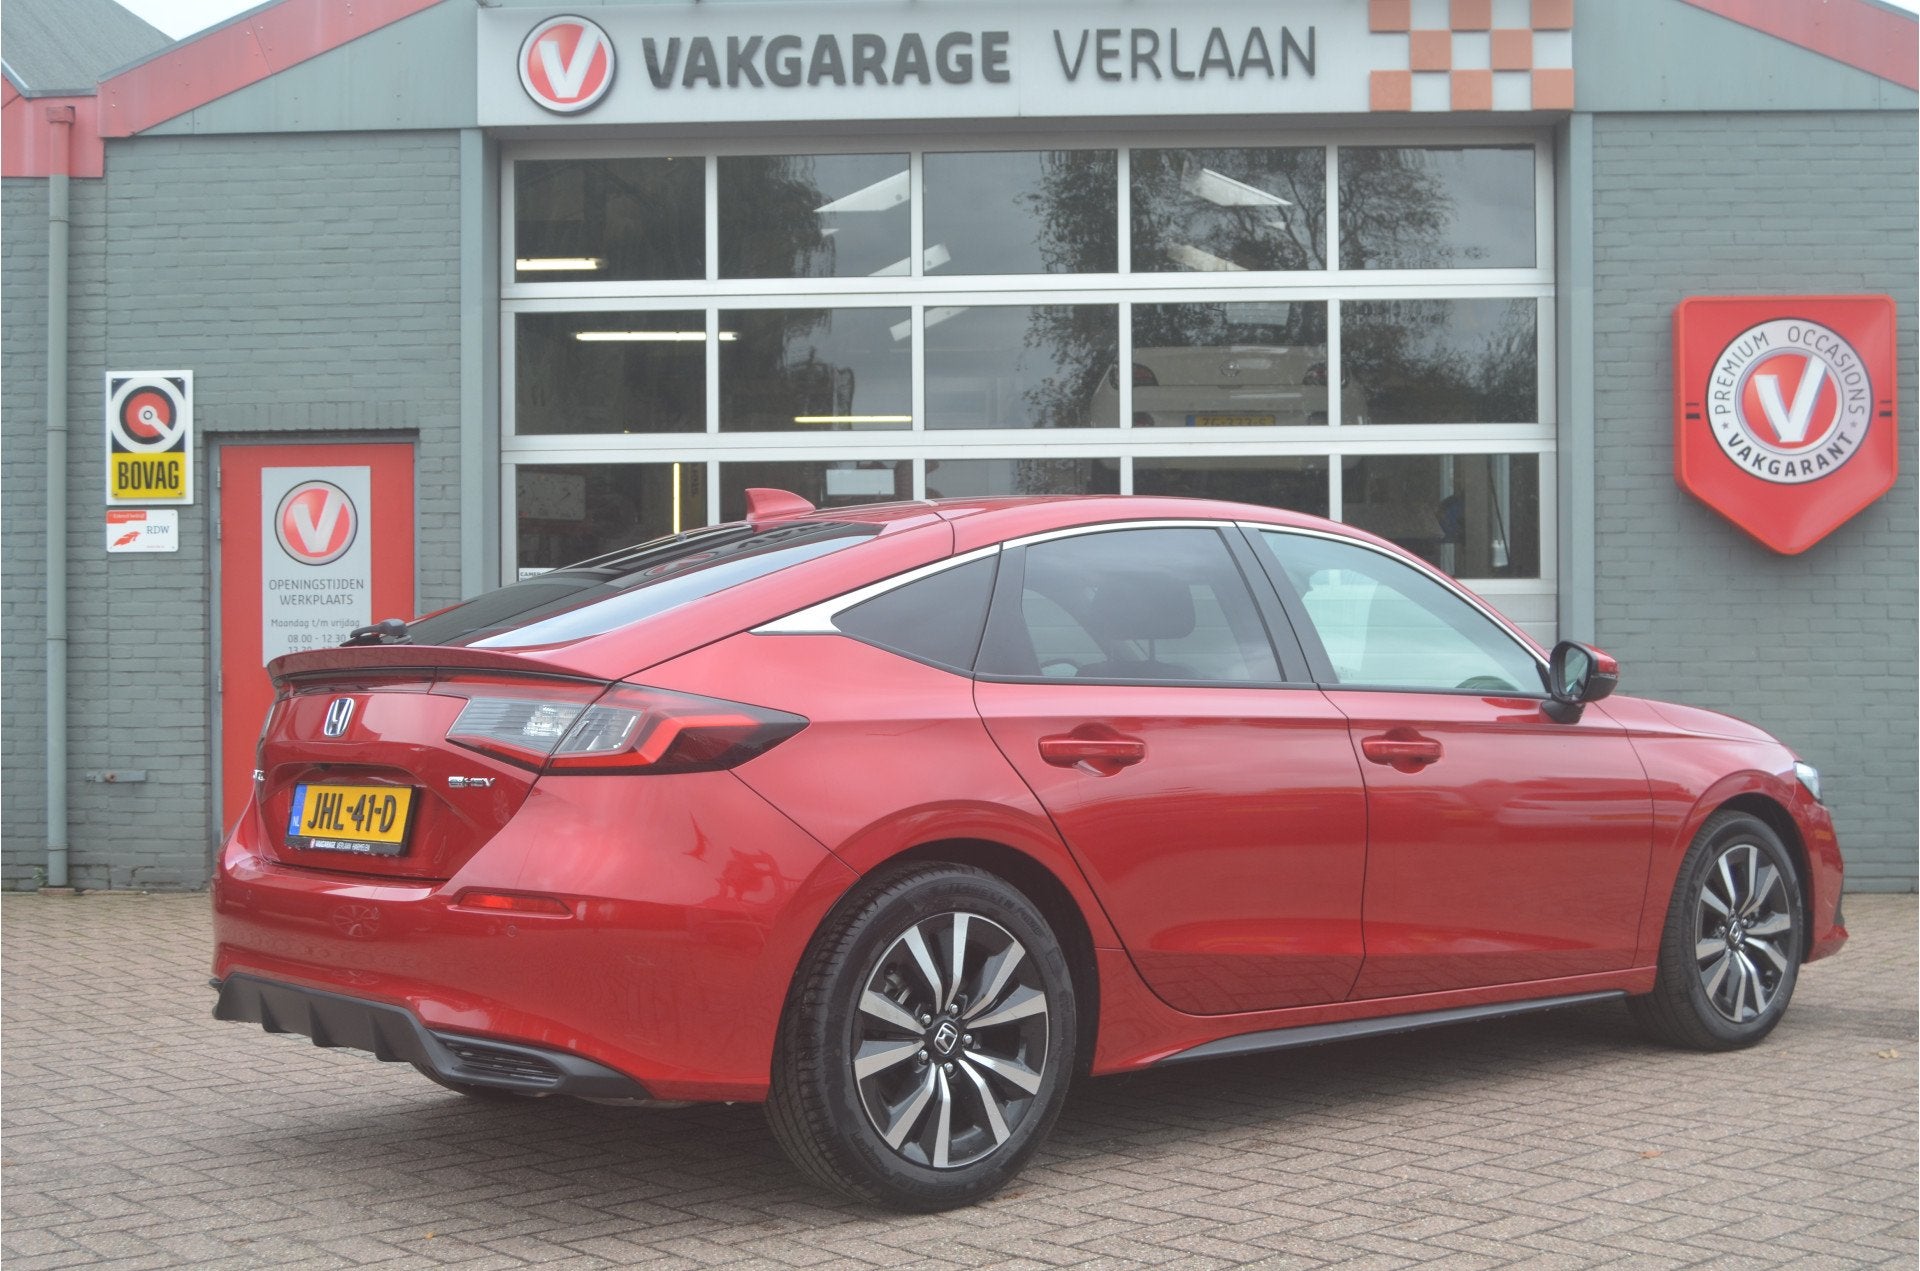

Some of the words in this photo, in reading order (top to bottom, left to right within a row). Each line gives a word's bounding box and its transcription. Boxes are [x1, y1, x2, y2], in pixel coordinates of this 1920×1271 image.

[641, 32, 1010, 88] VAKGARAGE
[1053, 26, 1317, 80] VERLAAN
[1714, 331, 1770, 415] PREMIUM
[1787, 326, 1865, 416] OCCASIONS
[1727, 432, 1854, 477] VAKGARANT
[118, 461, 179, 490] BOVAG
[146, 525, 170, 534] RDW
[269, 579, 364, 590] OPENINGSTIJDEN
[280, 594, 354, 605] WERKPLAATS
[271, 619, 309, 628] Maandag
[312, 618, 329, 627] t/m
[331, 619, 360, 629] vrijdag
[288, 634, 312, 643] 08.00
[322, 634, 346, 643] 12.30
[307, 792, 397, 833] JHL-41-D
[292, 815, 299, 827] NL
